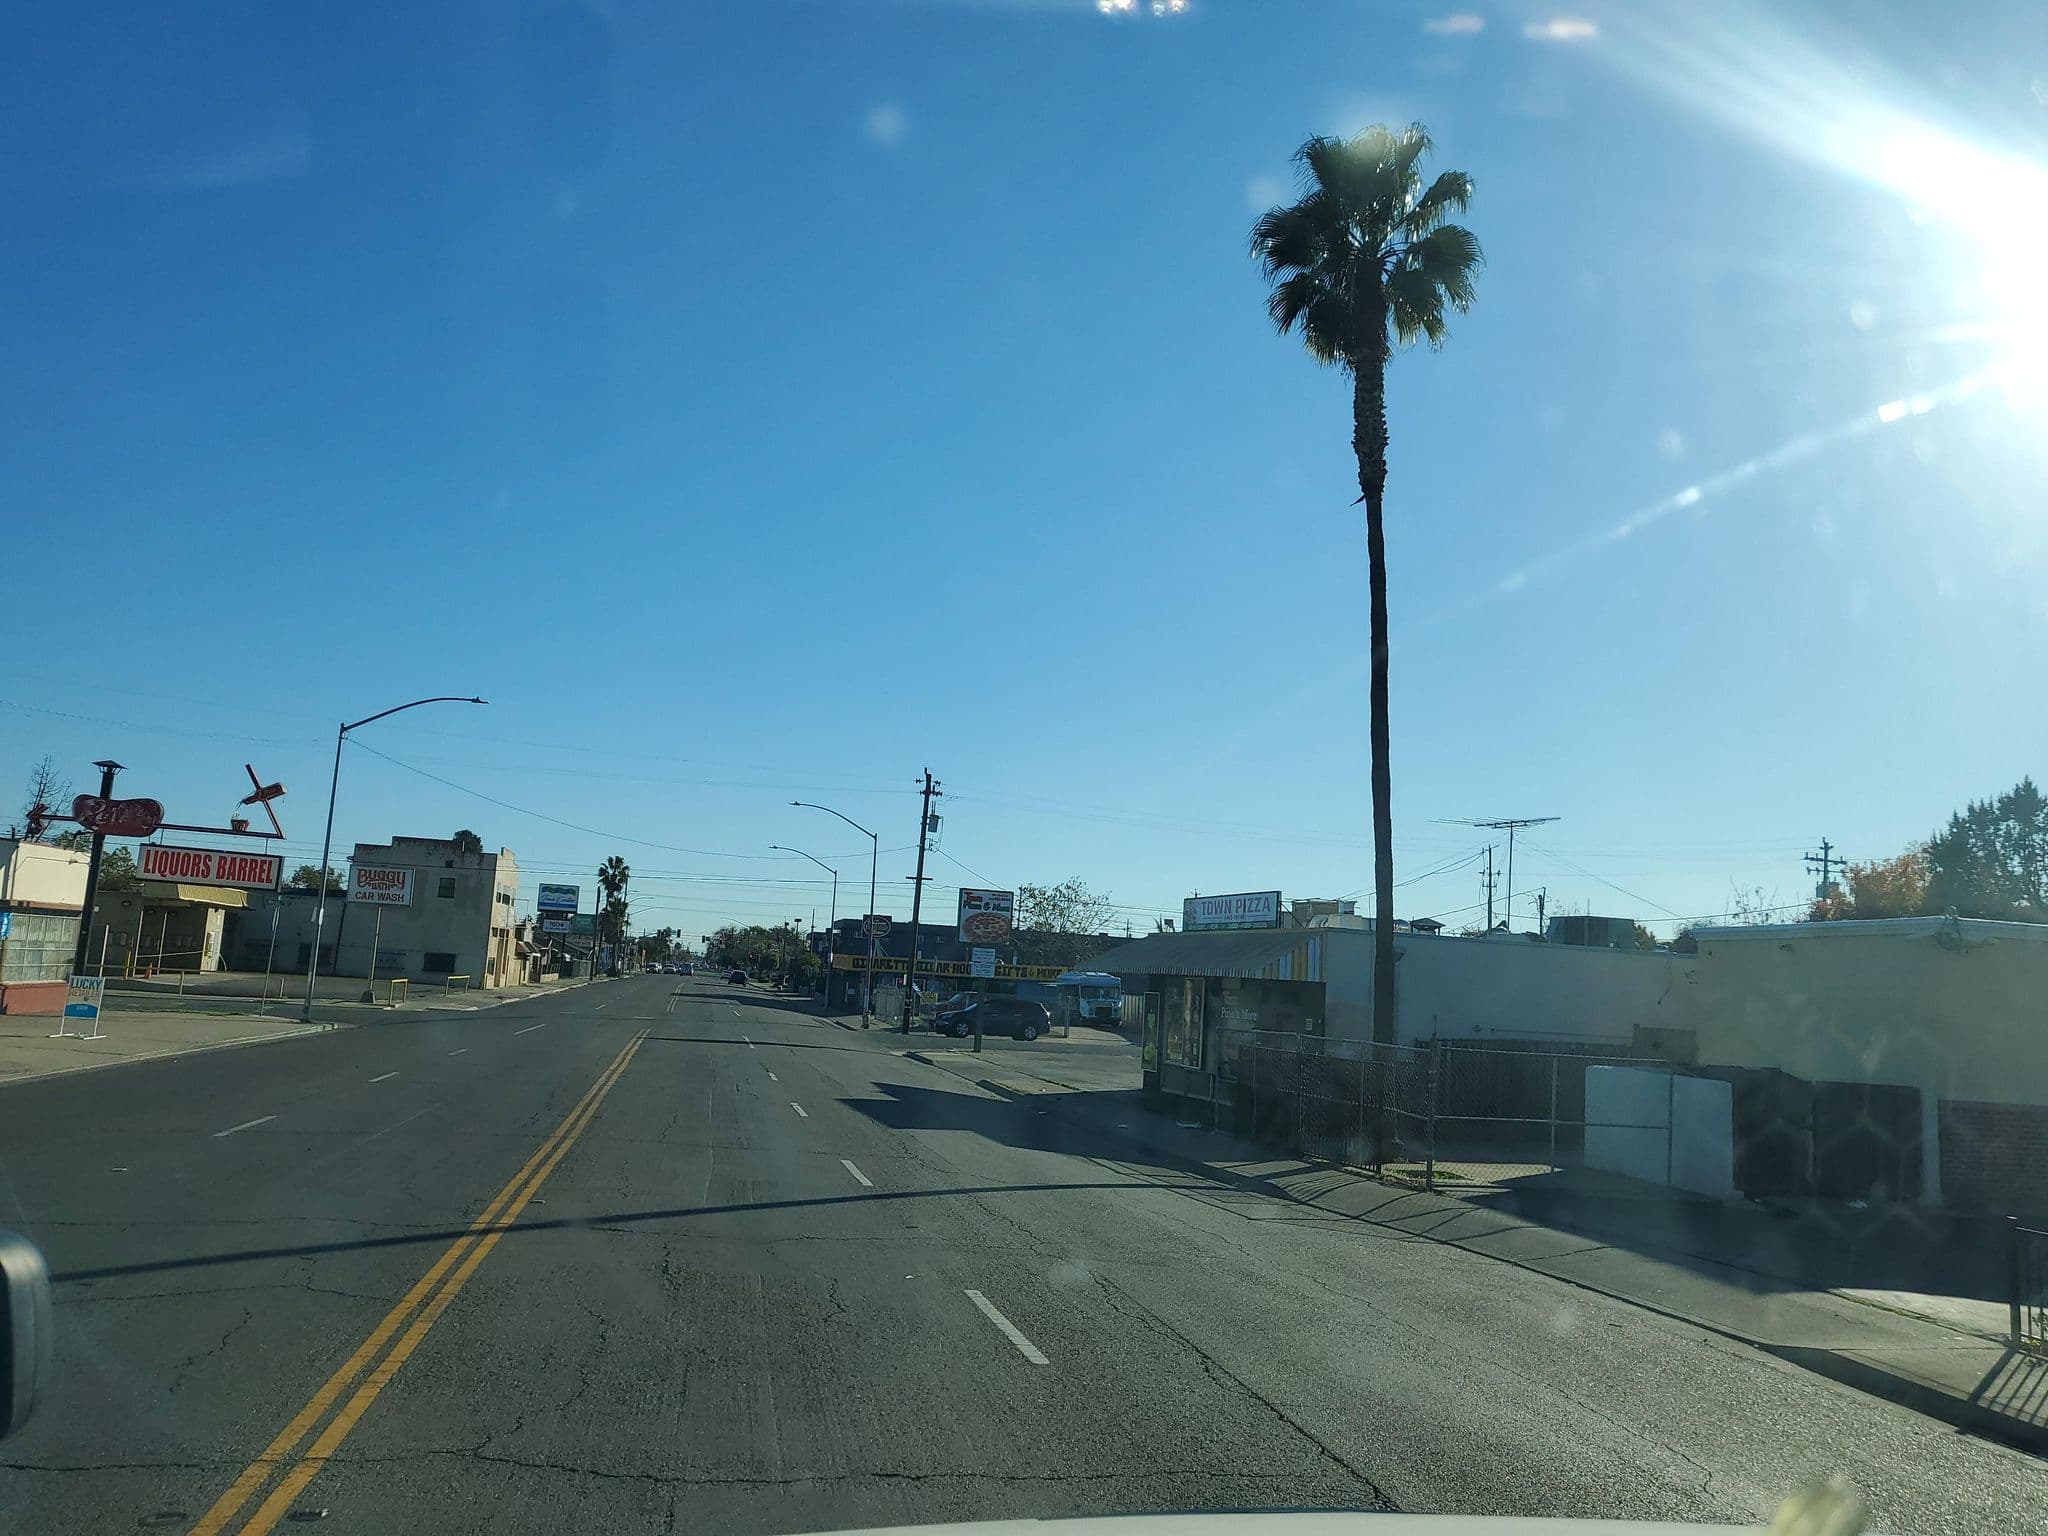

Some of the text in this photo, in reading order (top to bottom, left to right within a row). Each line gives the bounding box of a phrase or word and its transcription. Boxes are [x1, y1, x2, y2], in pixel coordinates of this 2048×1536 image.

[143, 850, 273, 884] LIQUORS BARREL
[357, 868, 406, 889] BUGGY
[355, 891, 404, 902] CAR WASH
[1201, 897, 1271, 915] TOWN PIZZA
[71, 977, 103, 990] LUCKY
